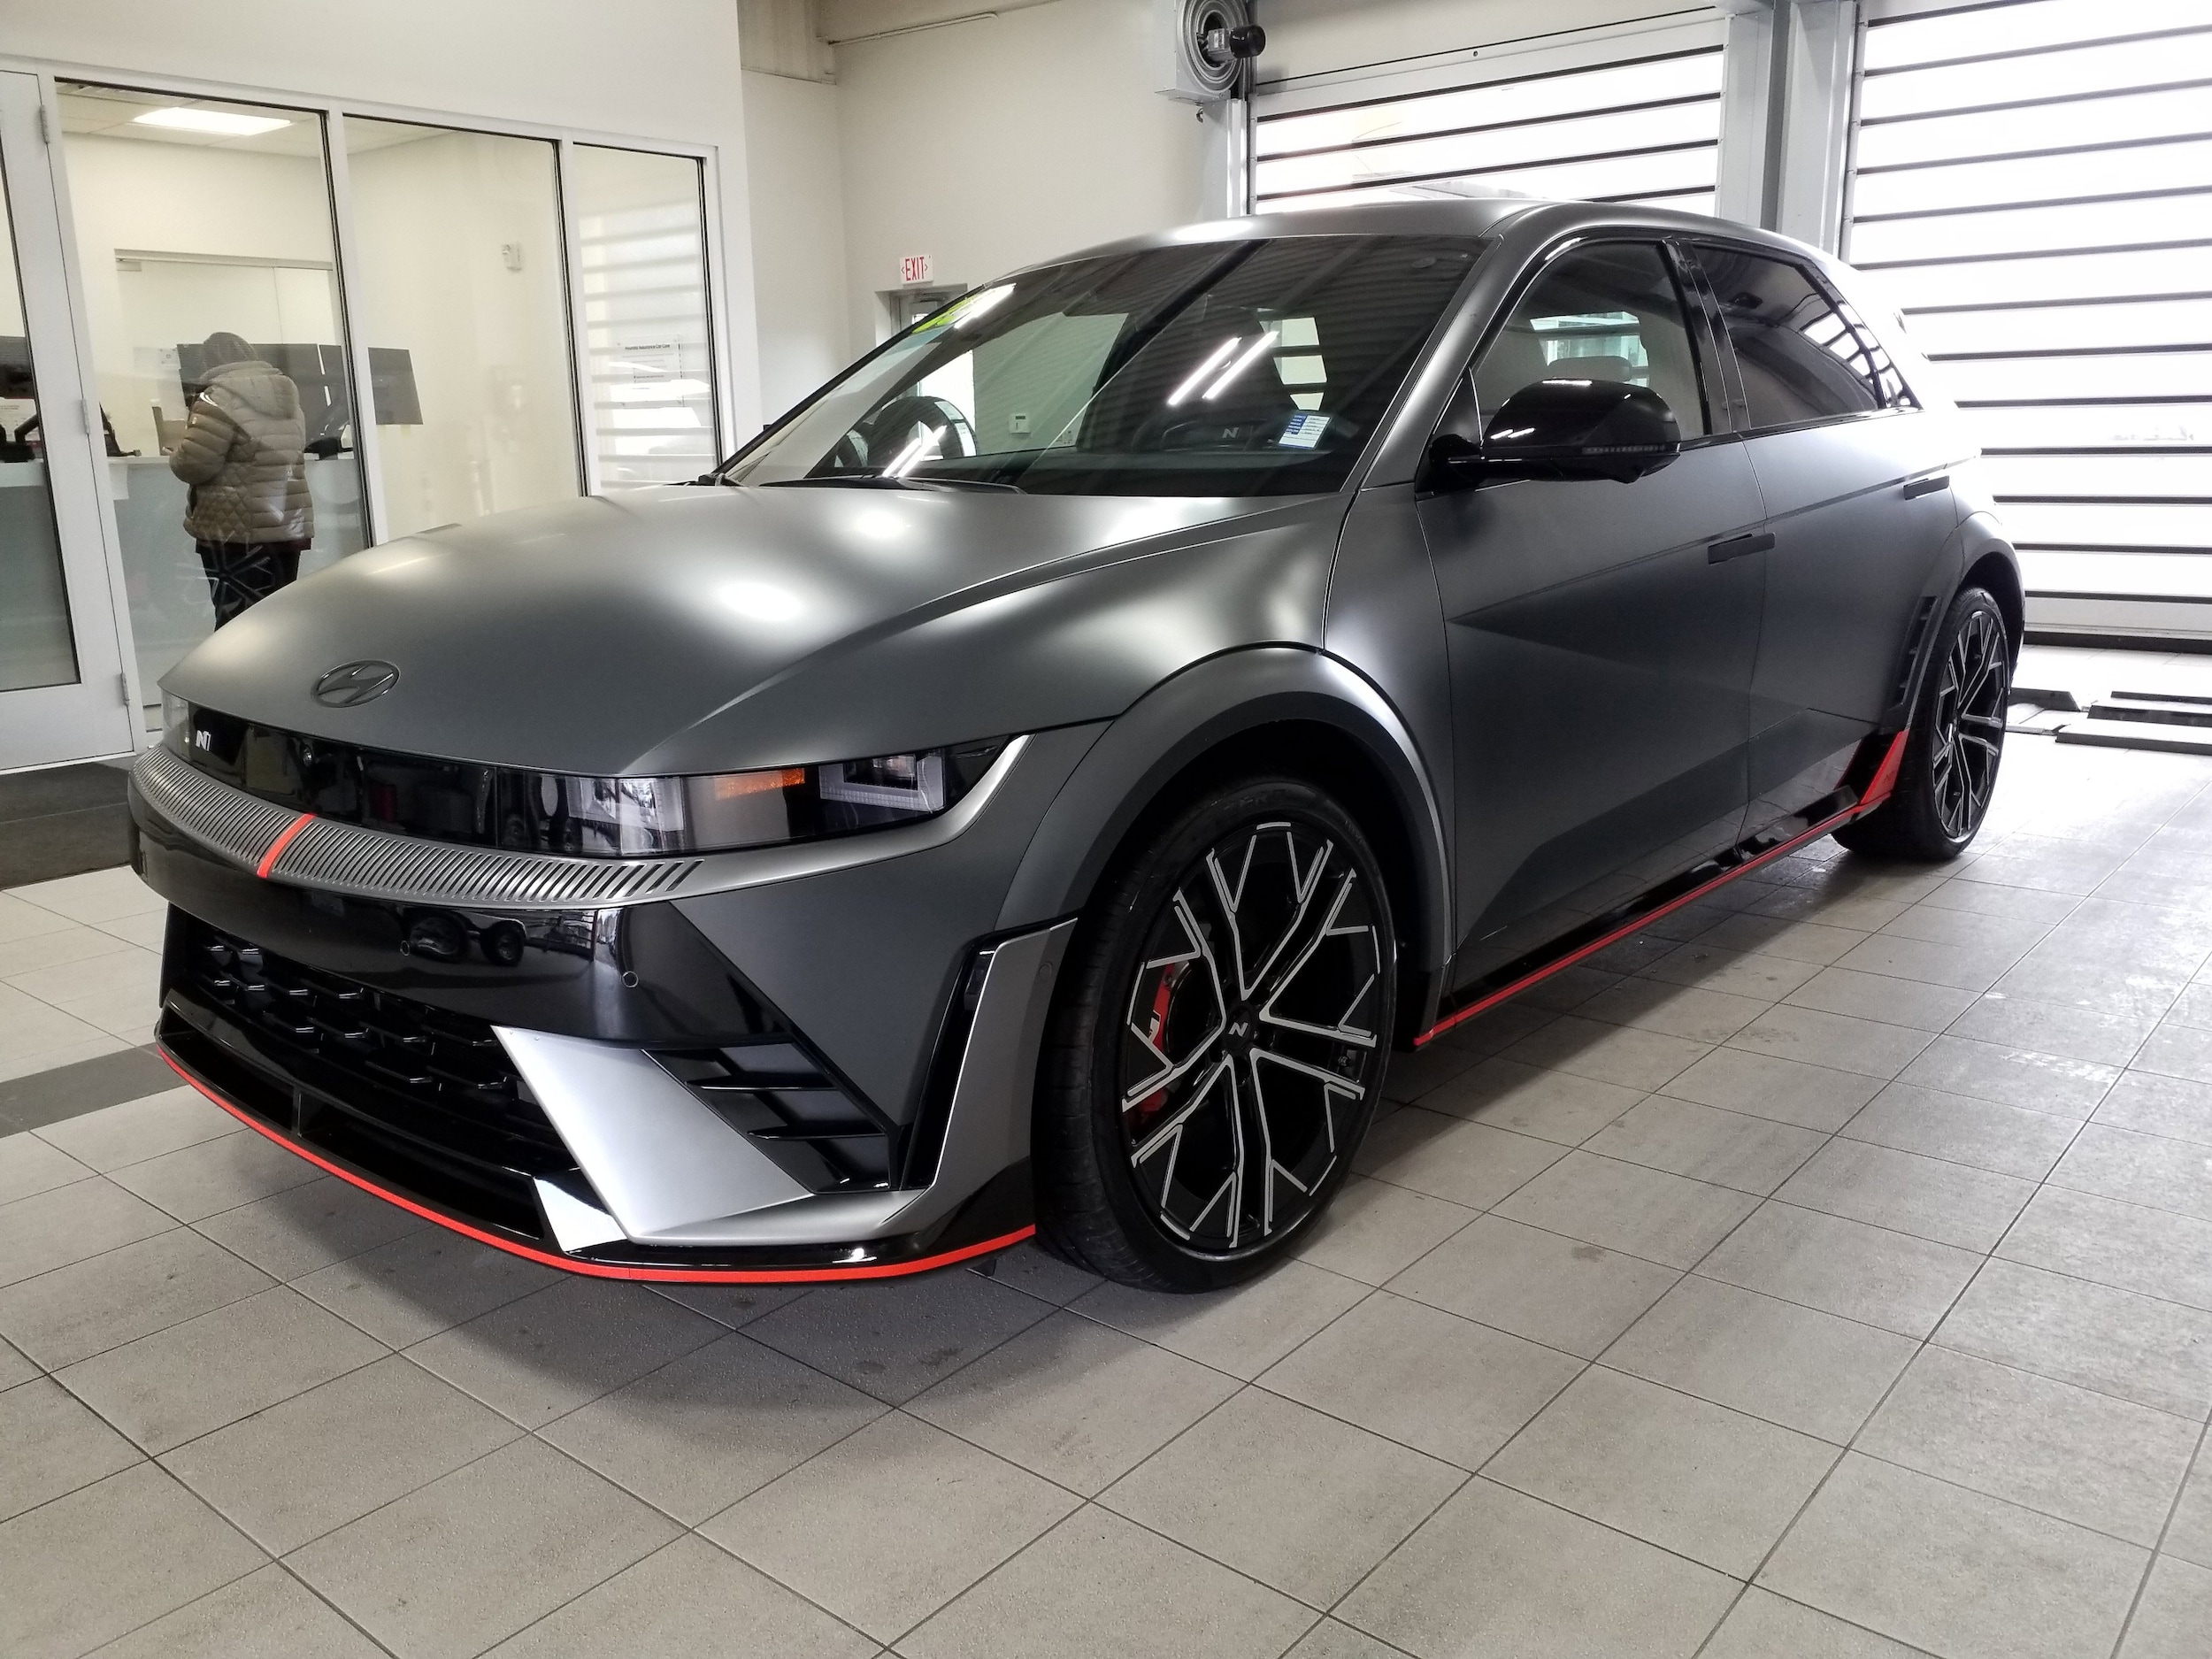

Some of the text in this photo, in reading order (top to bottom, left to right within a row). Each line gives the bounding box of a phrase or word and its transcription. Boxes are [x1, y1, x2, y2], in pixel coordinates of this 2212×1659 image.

[904, 256, 925, 281] EXIT
[1222, 426, 1240, 439] N
[1228, 1022, 1248, 1037] N
